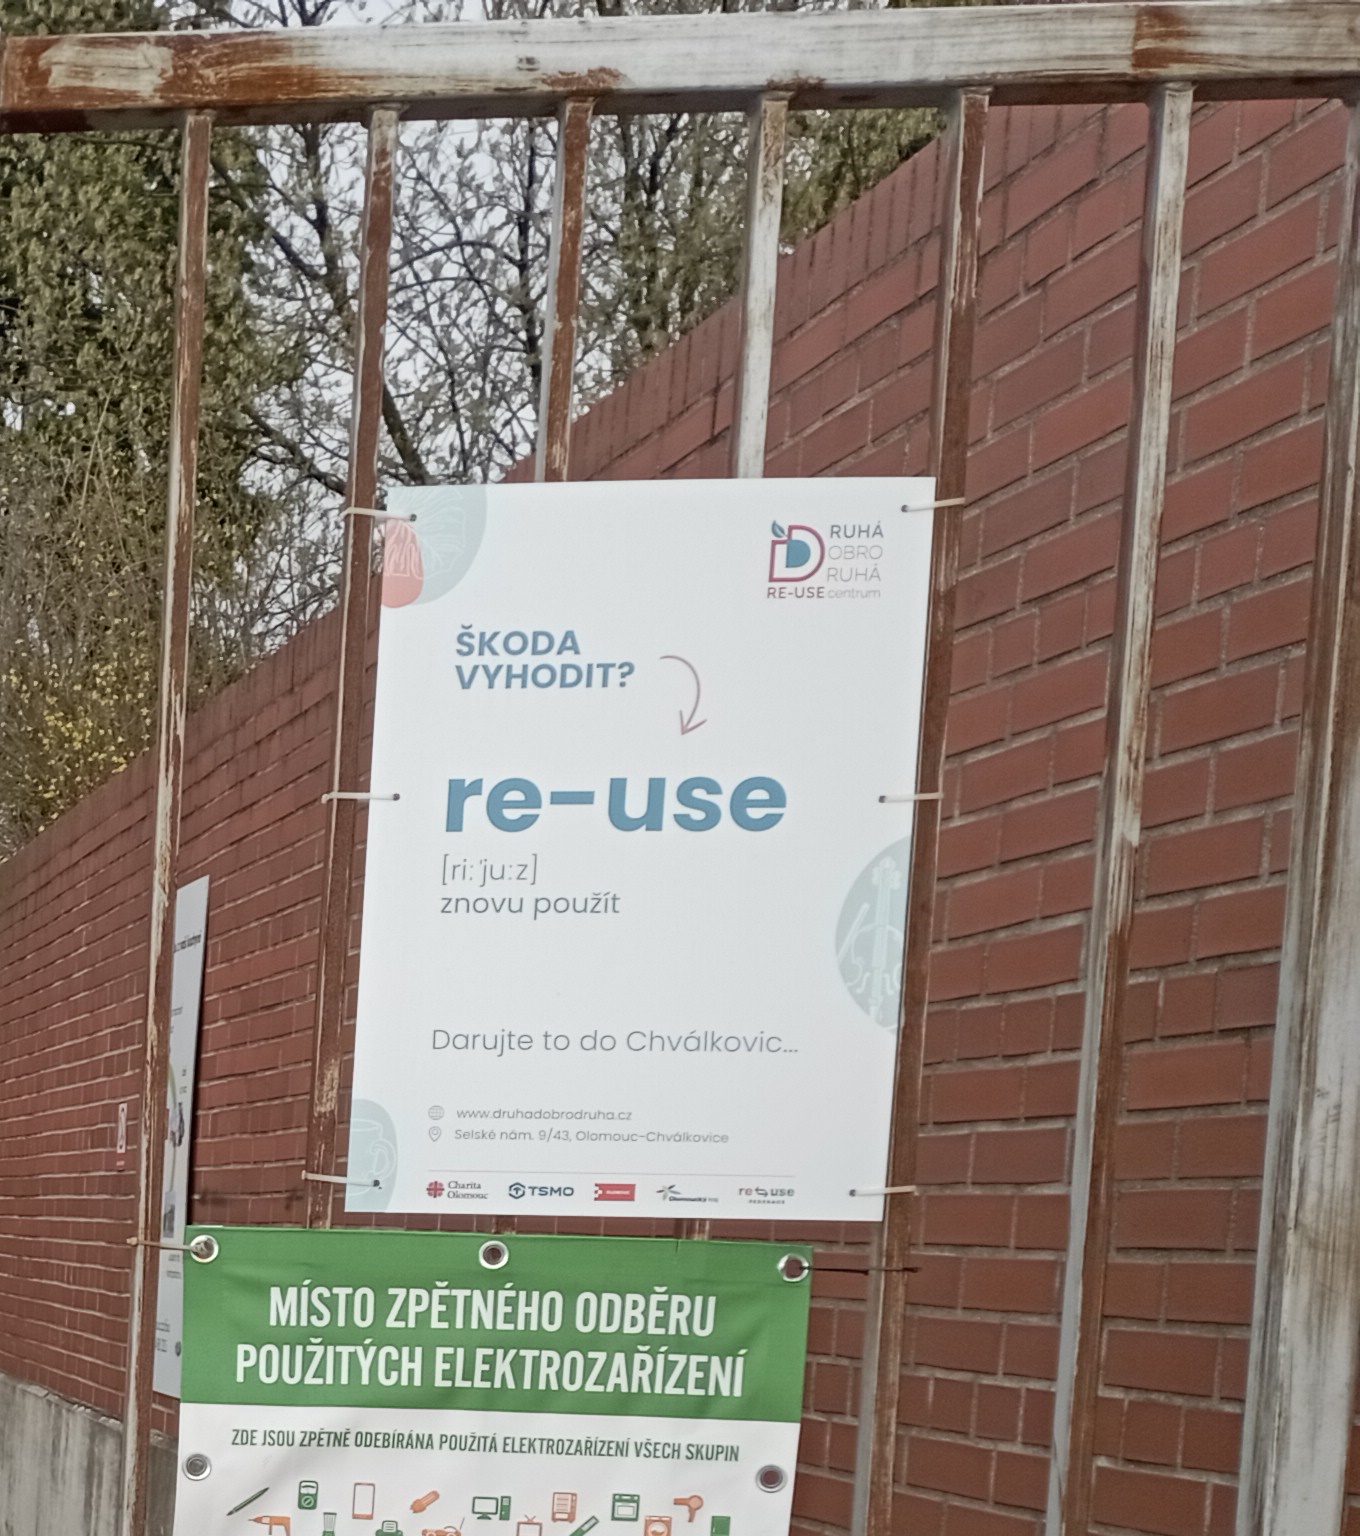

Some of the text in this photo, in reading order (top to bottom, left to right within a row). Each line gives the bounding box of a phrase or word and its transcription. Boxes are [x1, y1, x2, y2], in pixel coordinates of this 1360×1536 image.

[830, 521, 884, 539] RUHÁ
[828, 545, 883, 560] OBRO
[827, 563, 881, 582] RUHÁ
[766, 586, 881, 599] RE-USE centrum
[456, 624, 581, 657] ŠKODA
[455, 661, 635, 690] VYHODIT?
[445, 776, 787, 833] re-use
[440, 891, 621, 921] znovu použít
[431, 1029, 534, 1057] Darujte
[542, 1031, 571, 1052] to
[579, 1029, 617, 1052] do
[456, 1108, 633, 1121] www.druhadobrodruha.cz
[454, 1129, 729, 1144] Selské nám. 9/43, Olomouc-Chválkovice
[447, 1180, 482, 1190] Charita
[528, 1186, 575, 1197] TSMO
[447, 1190, 488, 1200] Olomouc
[270, 1279, 717, 1337] MÍSTO ZPĚTNÉHO ODBĚRU
[236, 1337, 749, 1398] POUŽITÝCH ELEKTROZAŘÍZENÍ
[232, 1428, 740, 1462] ZDE JSOU ZPĚTNĚ ODEBÍRÁNA POUŽITÁ ELEKTROZAŘÍZENÍ VŠECH SKUPIN
